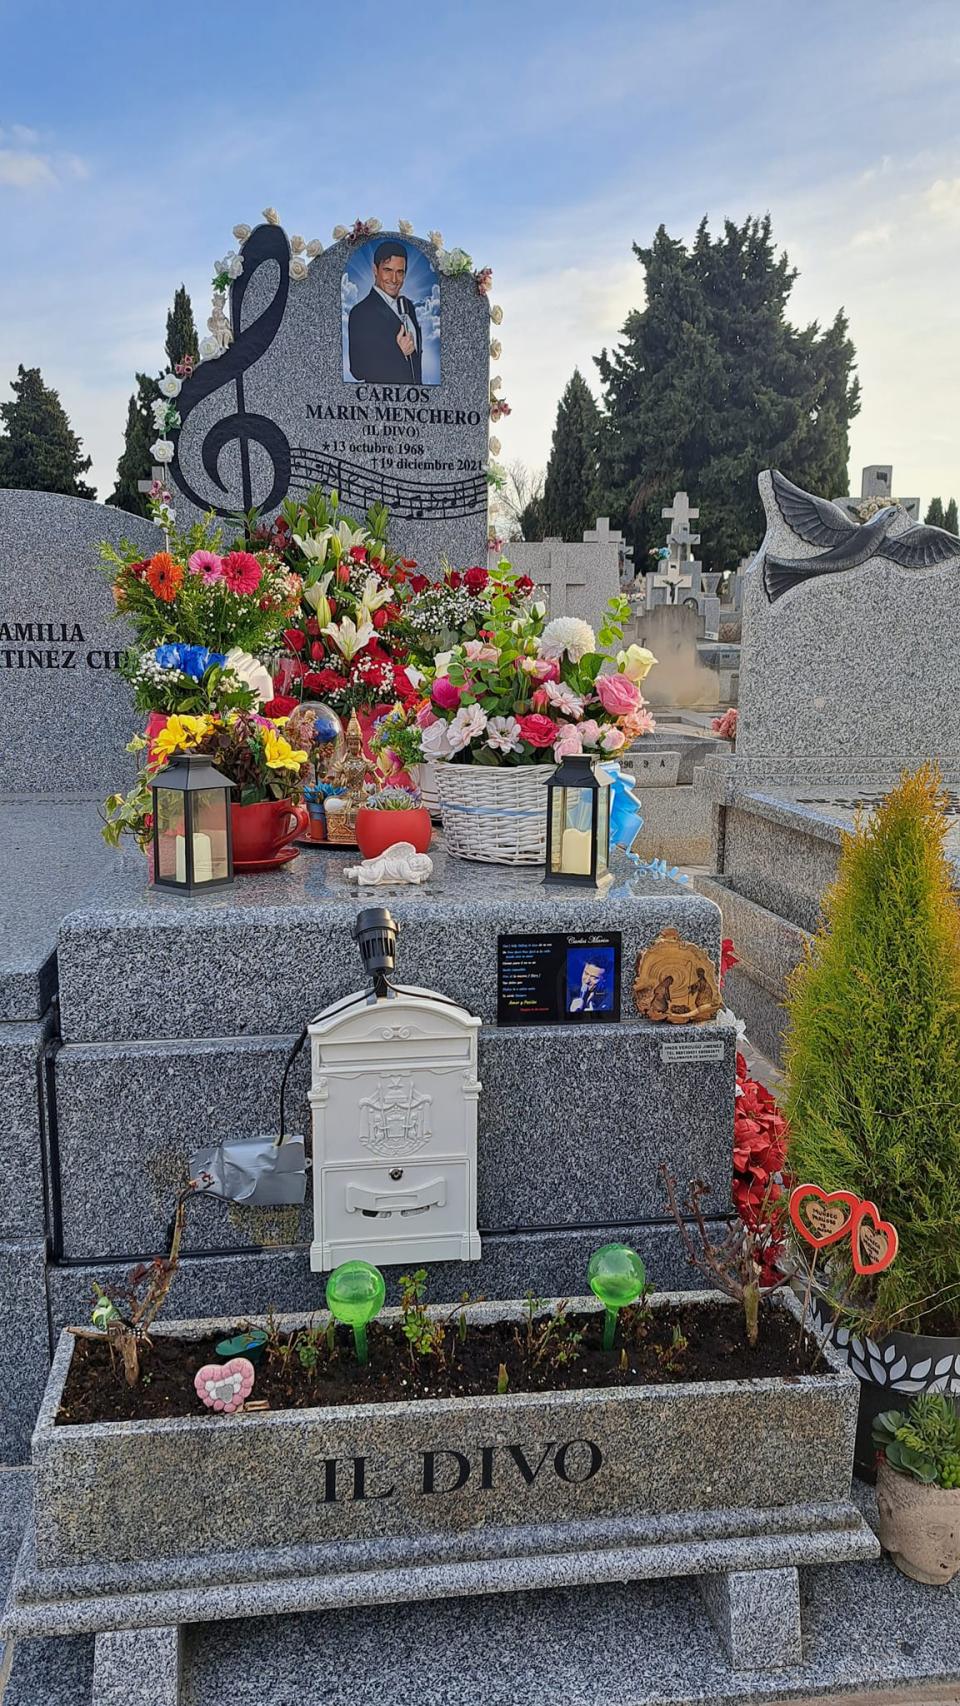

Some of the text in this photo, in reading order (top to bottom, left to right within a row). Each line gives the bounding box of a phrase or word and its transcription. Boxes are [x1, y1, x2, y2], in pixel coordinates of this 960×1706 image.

[355, 386, 430, 402] CARLOS
[305, 404, 481, 425] MARIN MENCHERO
[362, 425, 420, 437] (IL DIVO)
[350, 442, 394, 453] octubre
[400, 444, 425, 455] 1968
[396, 458, 454, 470] diciembre
[457, 459, 482, 471] 2021
[0, 649, 76, 669] TINEZ
[320, 1439, 602, 1503] IL DIVO
